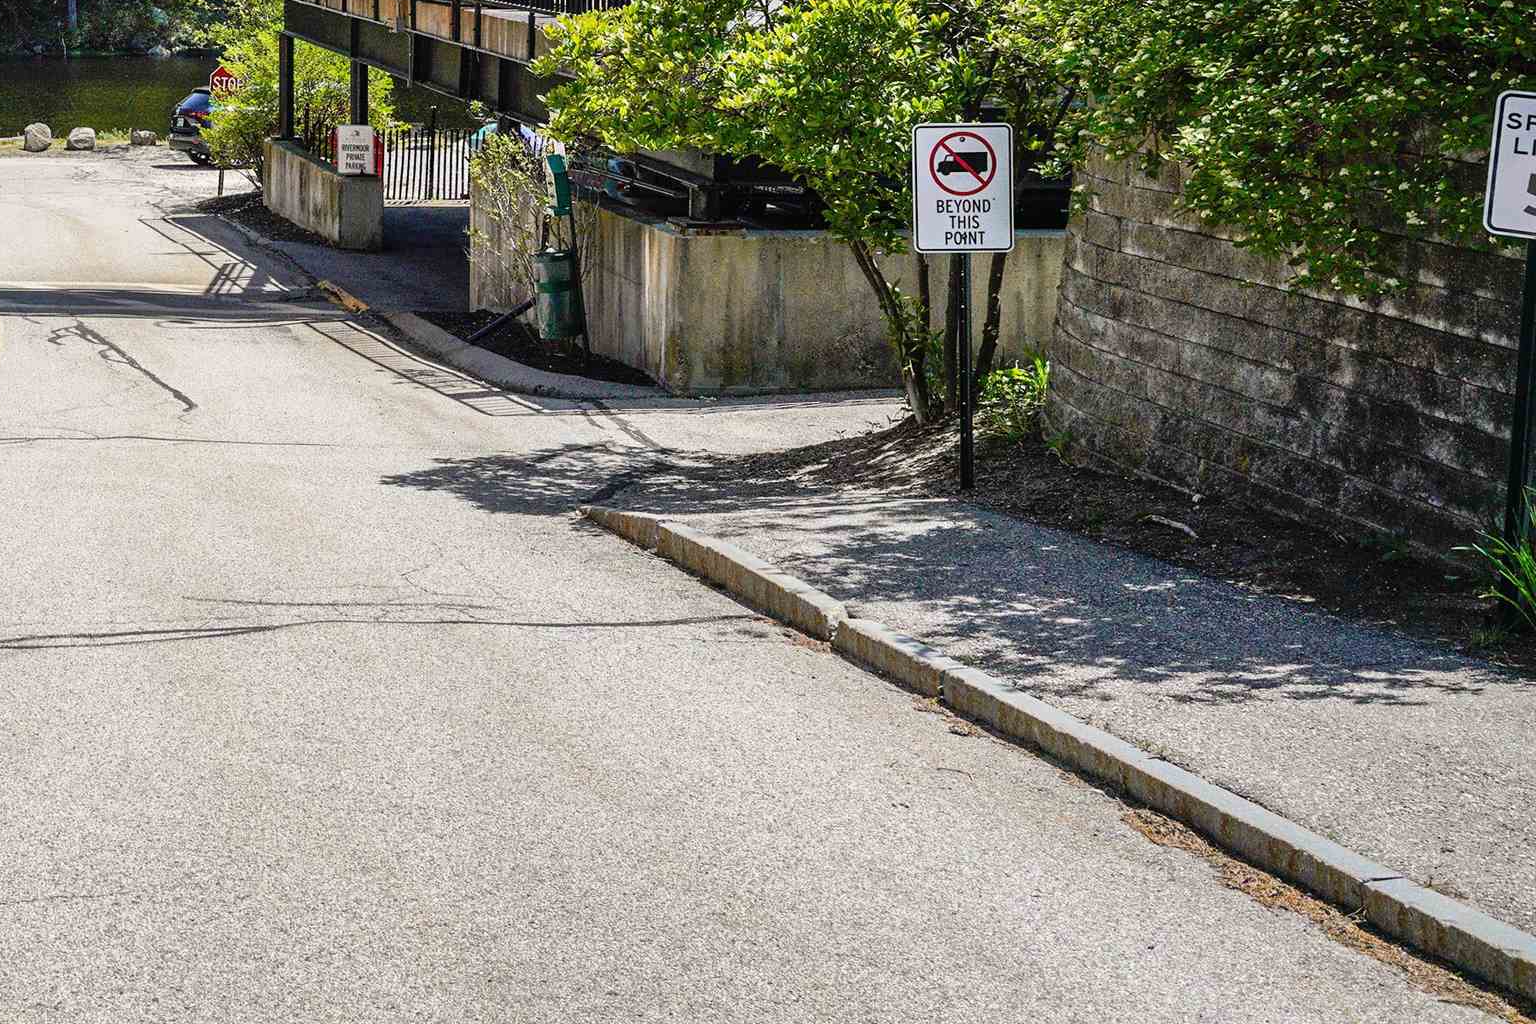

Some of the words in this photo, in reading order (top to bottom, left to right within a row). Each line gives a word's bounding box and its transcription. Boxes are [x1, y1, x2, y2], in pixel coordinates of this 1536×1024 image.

[345, 153, 366, 161] PRIVATE
[345, 162, 366, 170] PARKING
[936, 199, 991, 213] BEYOND
[949, 215, 980, 229] THIS
[945, 231, 985, 245] POINT
